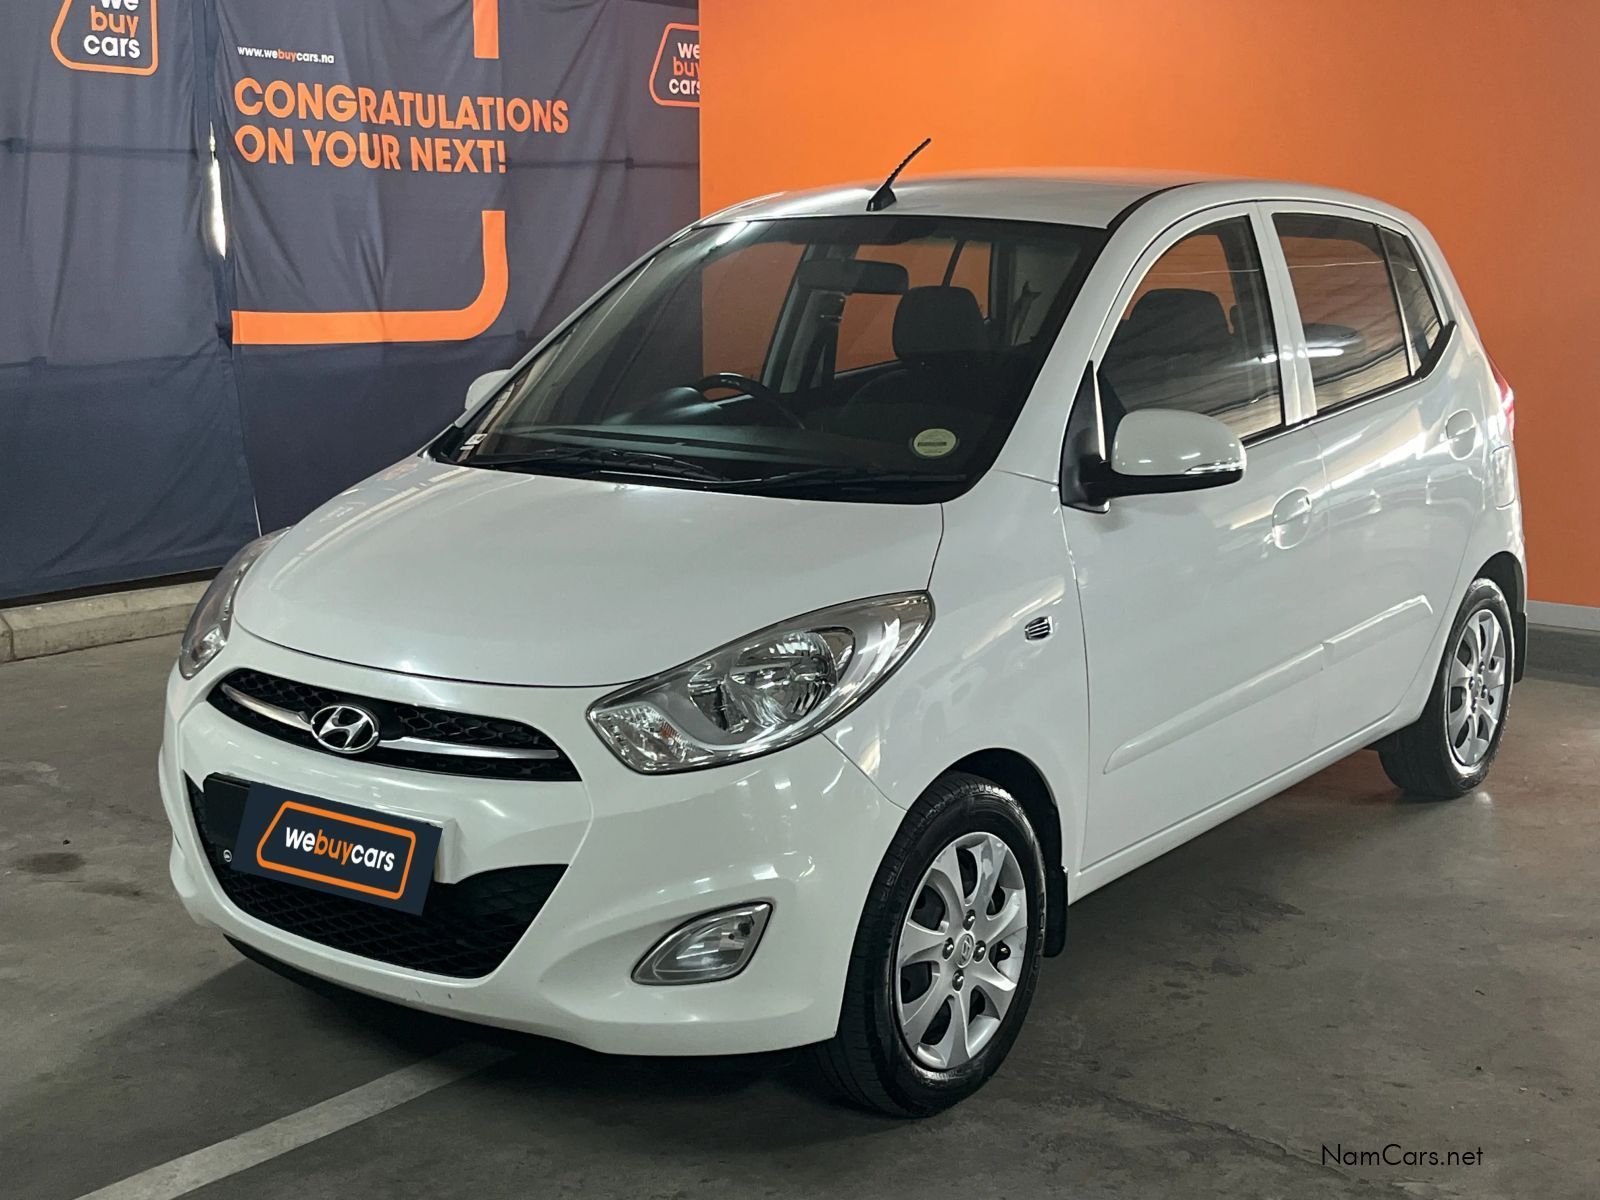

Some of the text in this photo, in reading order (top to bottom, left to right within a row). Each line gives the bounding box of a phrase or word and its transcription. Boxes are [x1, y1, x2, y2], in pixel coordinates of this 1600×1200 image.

[90, 5, 139, 38] buy
[83, 35, 140, 59] cars
[237, 46, 335, 64] www.webuycars.na
[234, 77, 569, 133] CONGRATULATIONS
[234, 125, 507, 174] ON YOUR NEXT!
